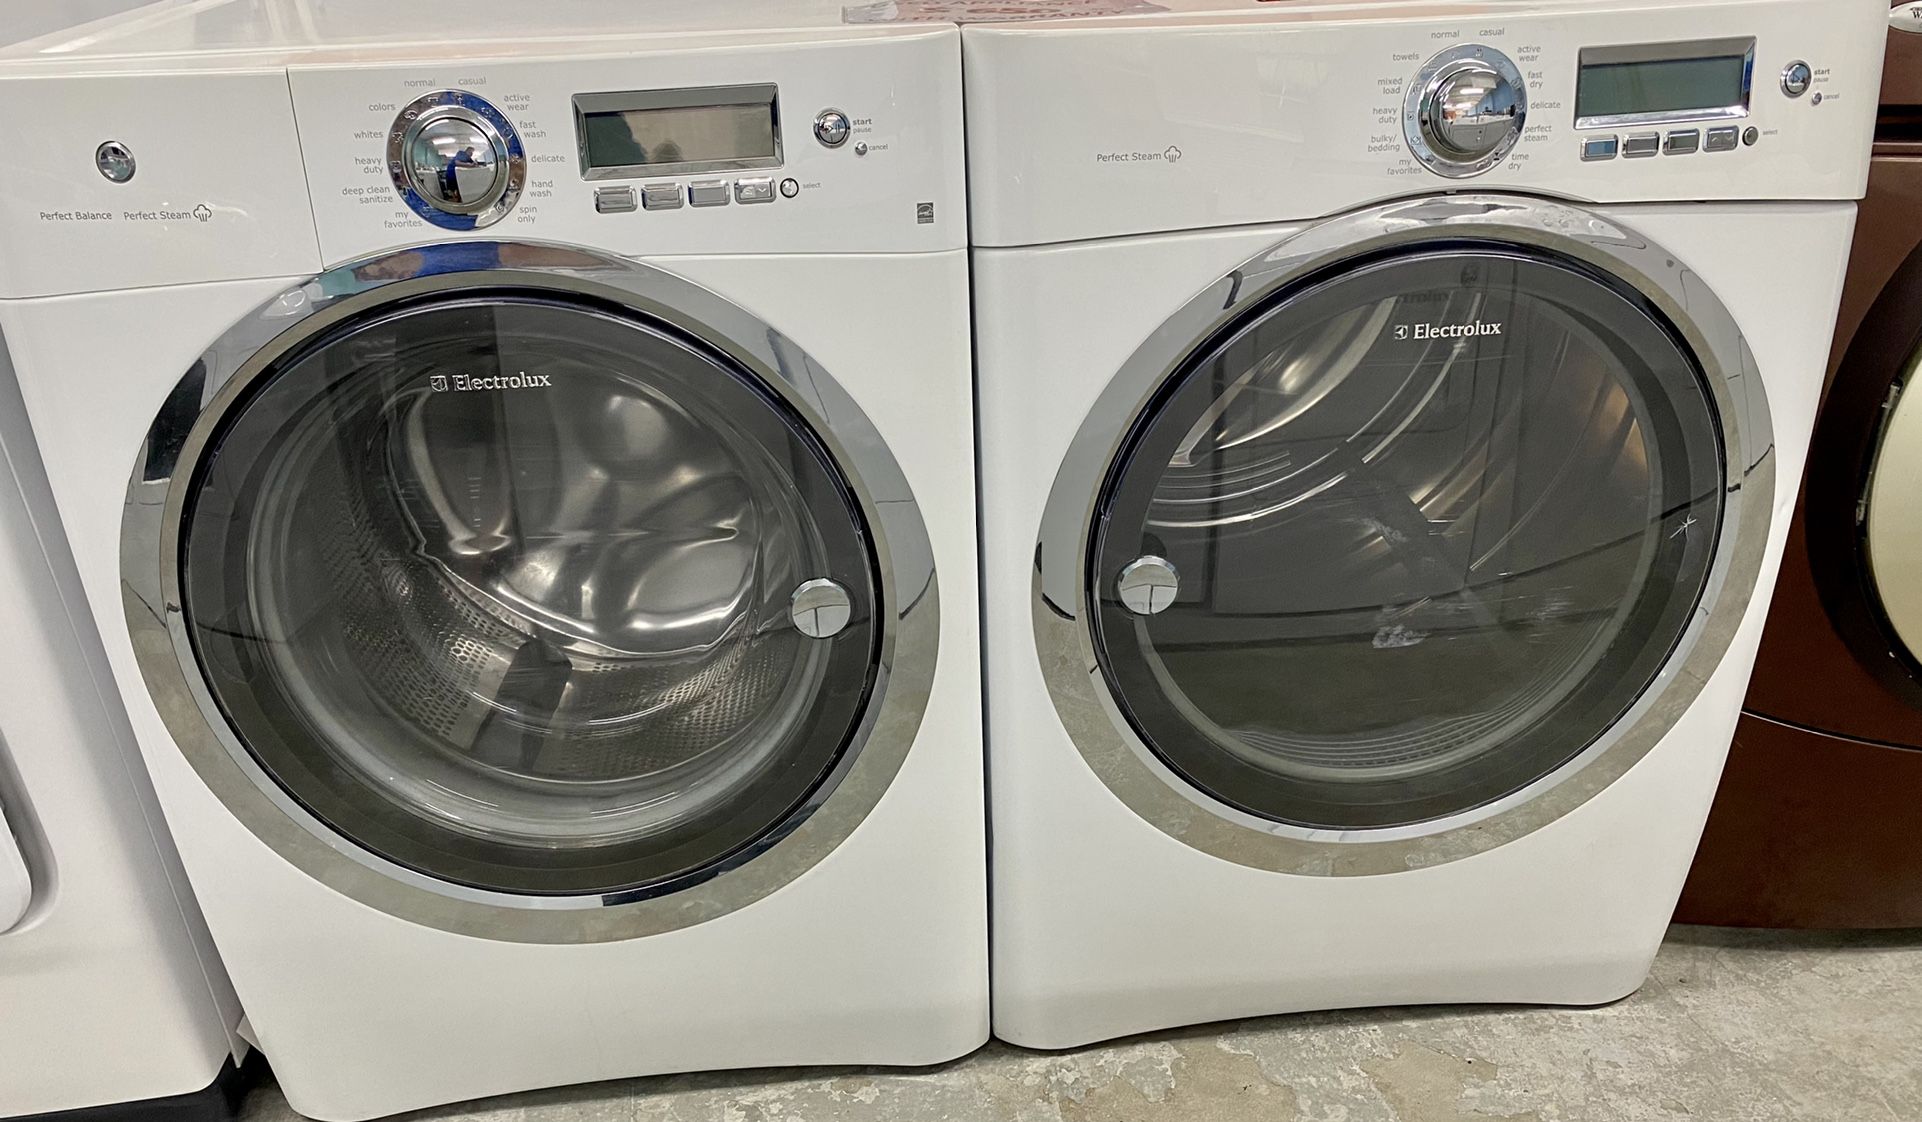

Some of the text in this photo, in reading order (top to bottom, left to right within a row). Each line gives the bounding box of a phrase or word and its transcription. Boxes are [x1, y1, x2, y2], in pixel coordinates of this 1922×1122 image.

[1430, 30, 1460, 39] normal
[1479, 27, 1505, 36] casual
[1517, 45, 1541, 54] active
[1392, 52, 1420, 61] towels
[1519, 54, 1539, 62] wear
[1527, 71, 1543, 79] fast
[403, 78, 436, 88] normal
[457, 76, 487, 86] casual
[1377, 77, 1403, 86] mixed
[1529, 80, 1543, 89] dry
[1383, 86, 1401, 95] load
[503, 93, 531, 103] active
[368, 102, 396, 112] colors
[506, 103, 529, 112] wear
[1530, 101, 1561, 110] delicate
[1372, 106, 1398, 116] heavy
[519, 120, 537, 129] fast
[852, 118, 873, 126] start
[1378, 115, 1398, 125] duty
[523, 130, 547, 139] wash
[1524, 124, 1553, 135] perfect
[353, 130, 384, 140] whites
[1370, 134, 1397, 144] bulky/
[1523, 133, 1549, 142] steam
[868, 143, 889, 152] cancel
[1367, 143, 1401, 153] bedding
[354, 156, 383, 167] heavy
[530, 155, 566, 164] delicate
[1096, 152, 1162, 162] Perfect Steam
[1511, 152, 1530, 161] time
[1398, 159, 1413, 167] my
[1507, 161, 1522, 172] dry
[362, 164, 385, 175] duty
[1386, 165, 1423, 176] favorites
[531, 179, 554, 189] hand
[341, 185, 391, 198] deep clean
[529, 189, 553, 199] wash
[358, 195, 394, 205] sanitize
[39, 210, 113, 221] Perfect Balance
[123, 210, 192, 221] Perfect Steam
[394, 210, 409, 220] my
[519, 205, 538, 216] spin
[384, 219, 424, 230] favorites
[517, 214, 537, 225] only
[1413, 319, 1502, 340] Electrolux
[452, 371, 552, 391] Electrolux
